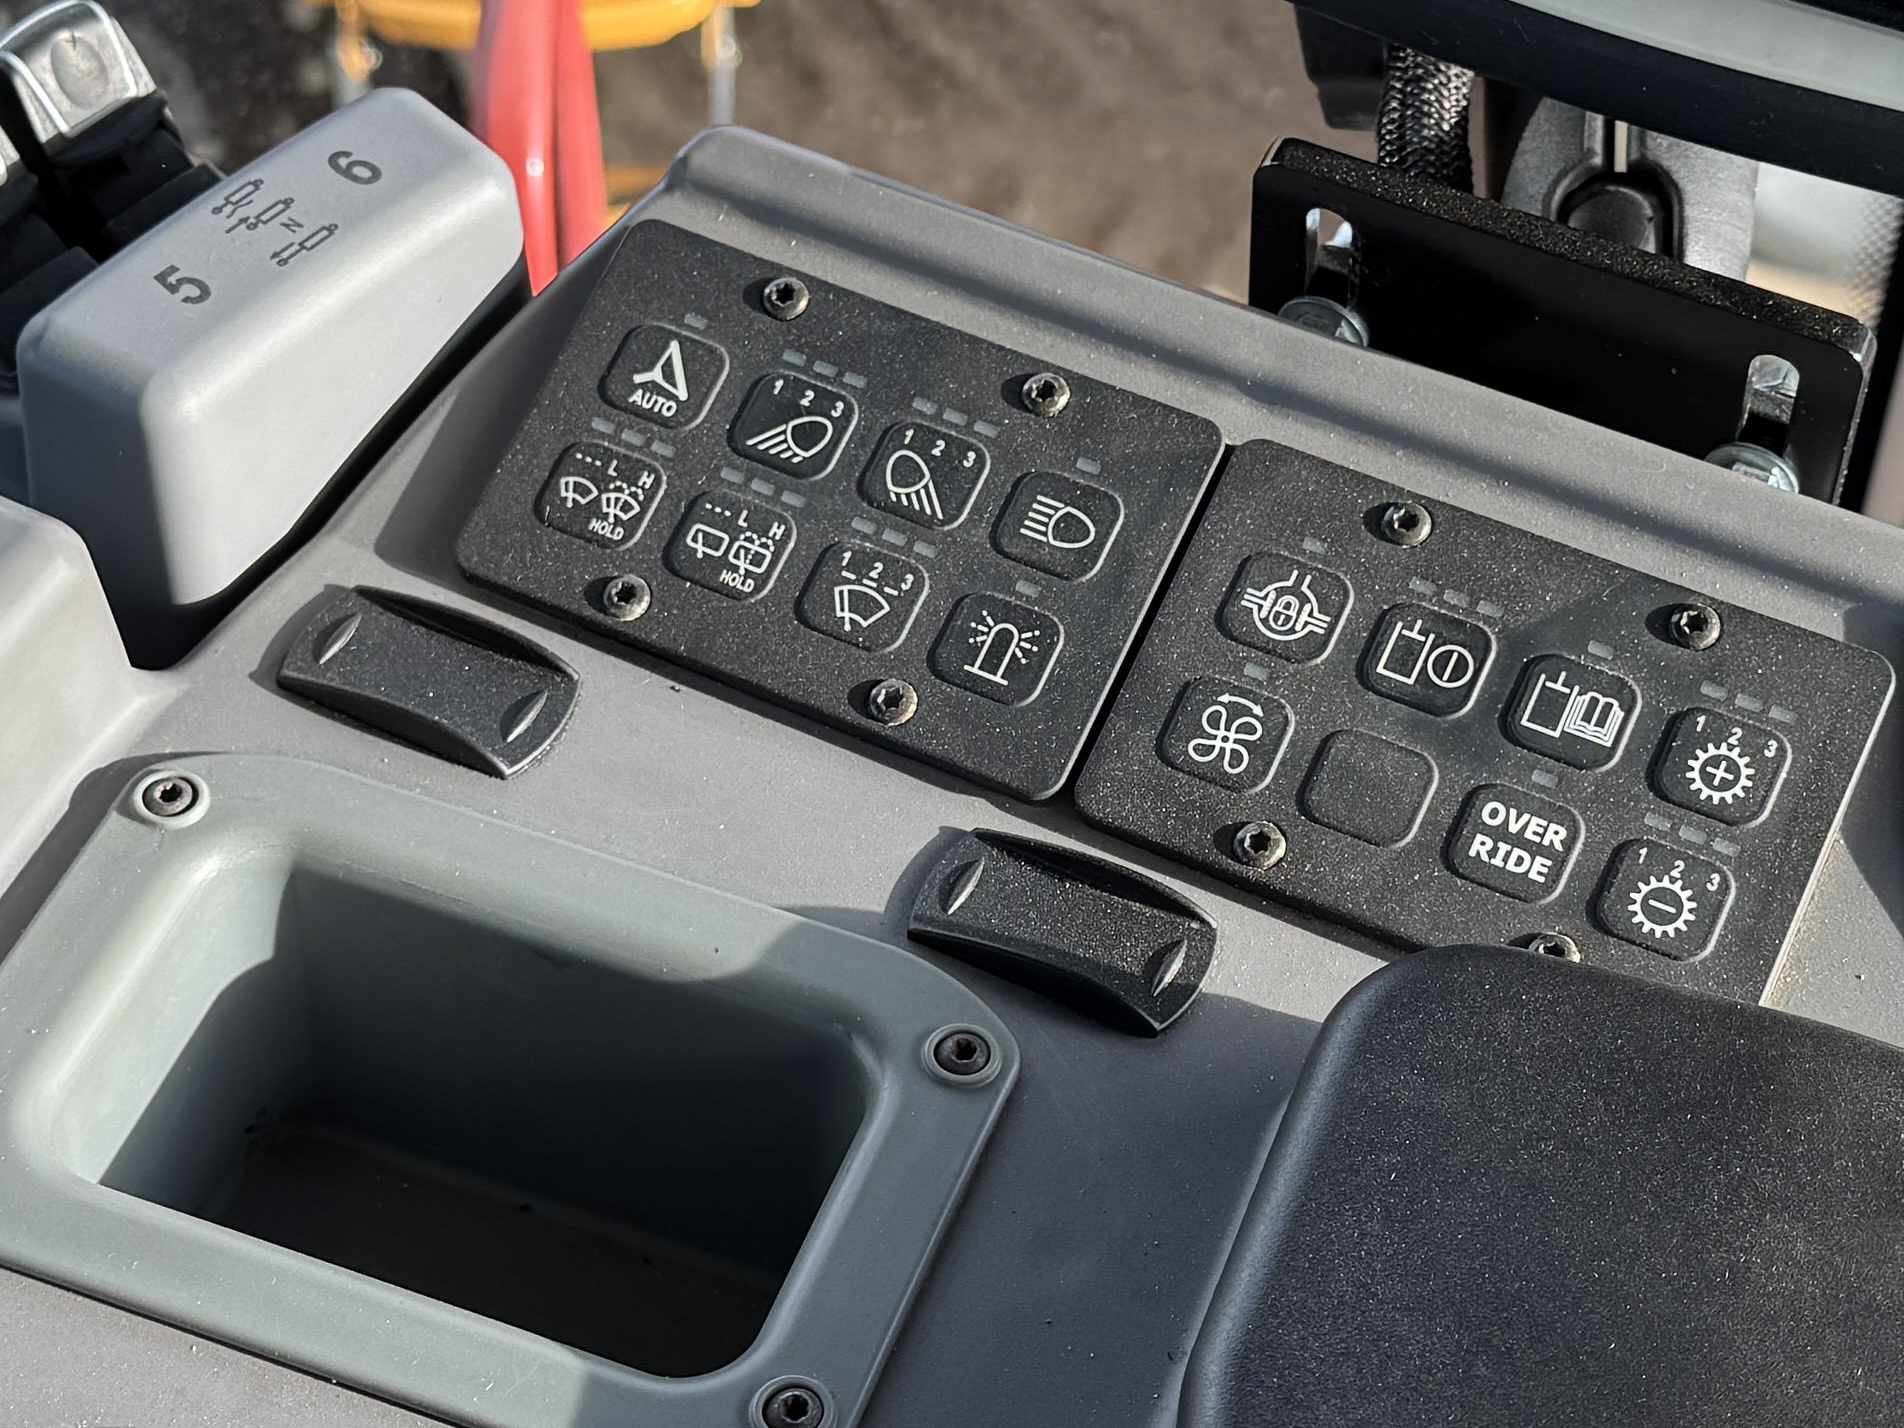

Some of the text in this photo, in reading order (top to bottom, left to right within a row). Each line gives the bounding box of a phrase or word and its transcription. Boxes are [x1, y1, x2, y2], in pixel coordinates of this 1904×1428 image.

[152, 150, 383, 305] 5 6
[628, 389, 678, 417] AUTO
[773, 378, 845, 418] 1 2 3
[903, 428, 977, 468] 1 2 3
[607, 459, 656, 490] L H
[588, 517, 625, 541] HOLD
[737, 509, 786, 541] L H
[719, 568, 755, 593] HOLD
[841, 550, 914, 591] 1 2 3
[1696, 714, 1779, 758] 1 2 3
[1480, 801, 1568, 852] OVER
[1468, 834, 1553, 883] RIDE
[1638, 847, 1721, 892] 1 2 3
